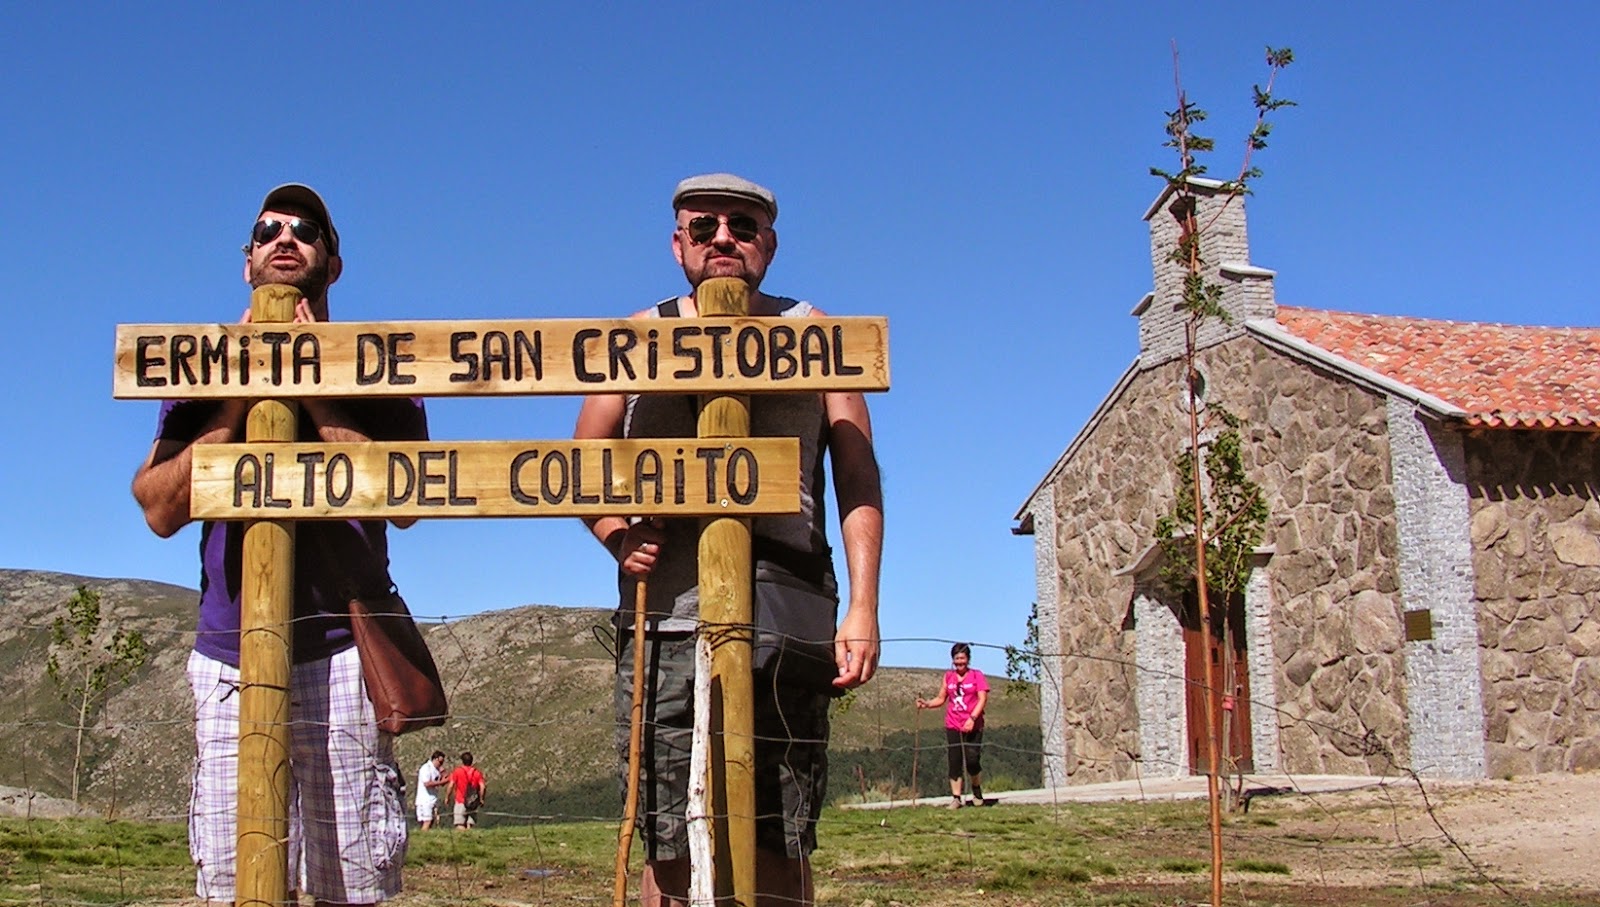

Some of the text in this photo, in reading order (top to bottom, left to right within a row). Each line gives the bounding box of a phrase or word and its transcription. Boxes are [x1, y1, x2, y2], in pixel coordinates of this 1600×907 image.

[356, 332, 417, 386] DE
[449, 330, 543, 382] SAN
[233, 451, 352, 508] ALTO
[387, 450, 477, 507] DEL
